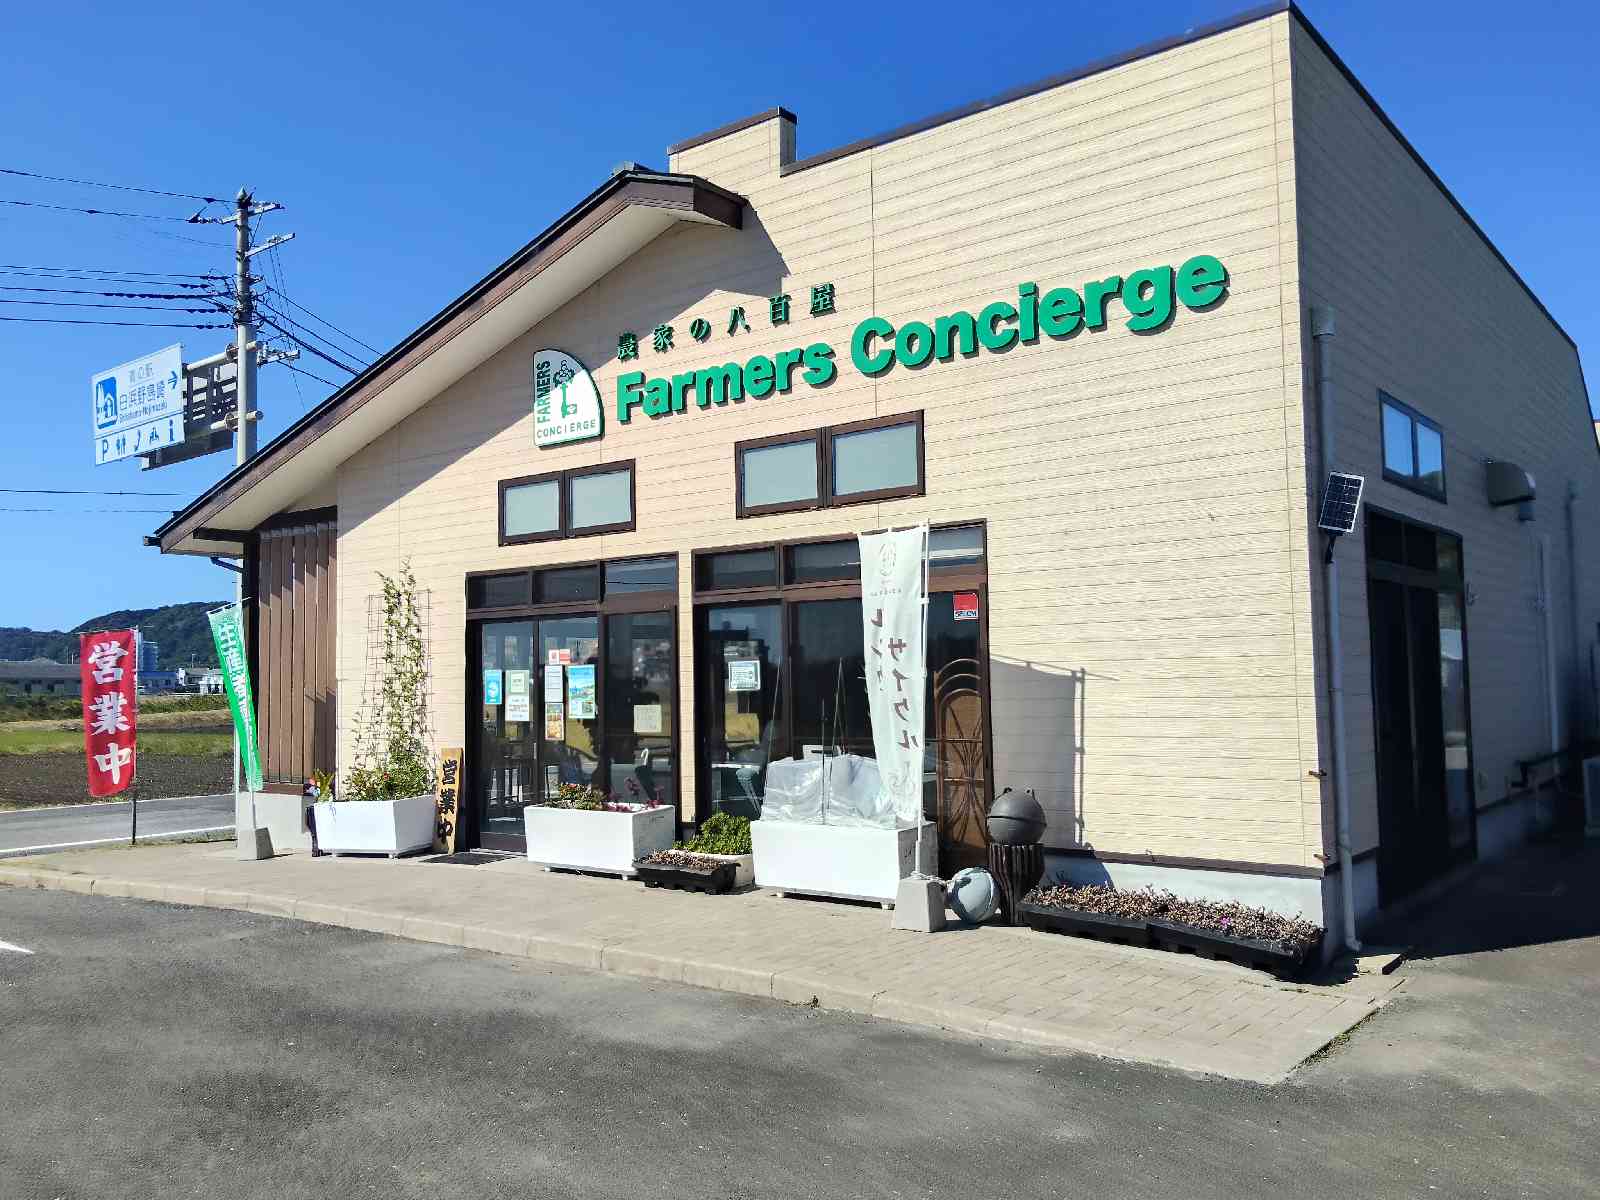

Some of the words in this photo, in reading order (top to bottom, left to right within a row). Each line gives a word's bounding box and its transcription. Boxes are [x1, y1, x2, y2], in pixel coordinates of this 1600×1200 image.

[617, 282, 836, 361] 農家の八百屋
[617, 342, 838, 424] Farmers
[851, 255, 1230, 377] Concierge
[535, 359, 552, 424] FARMERS
[102, 439, 109, 461] P
[536, 419, 596, 440] CONCIERGE
[88, 640, 132, 785] 営業中
